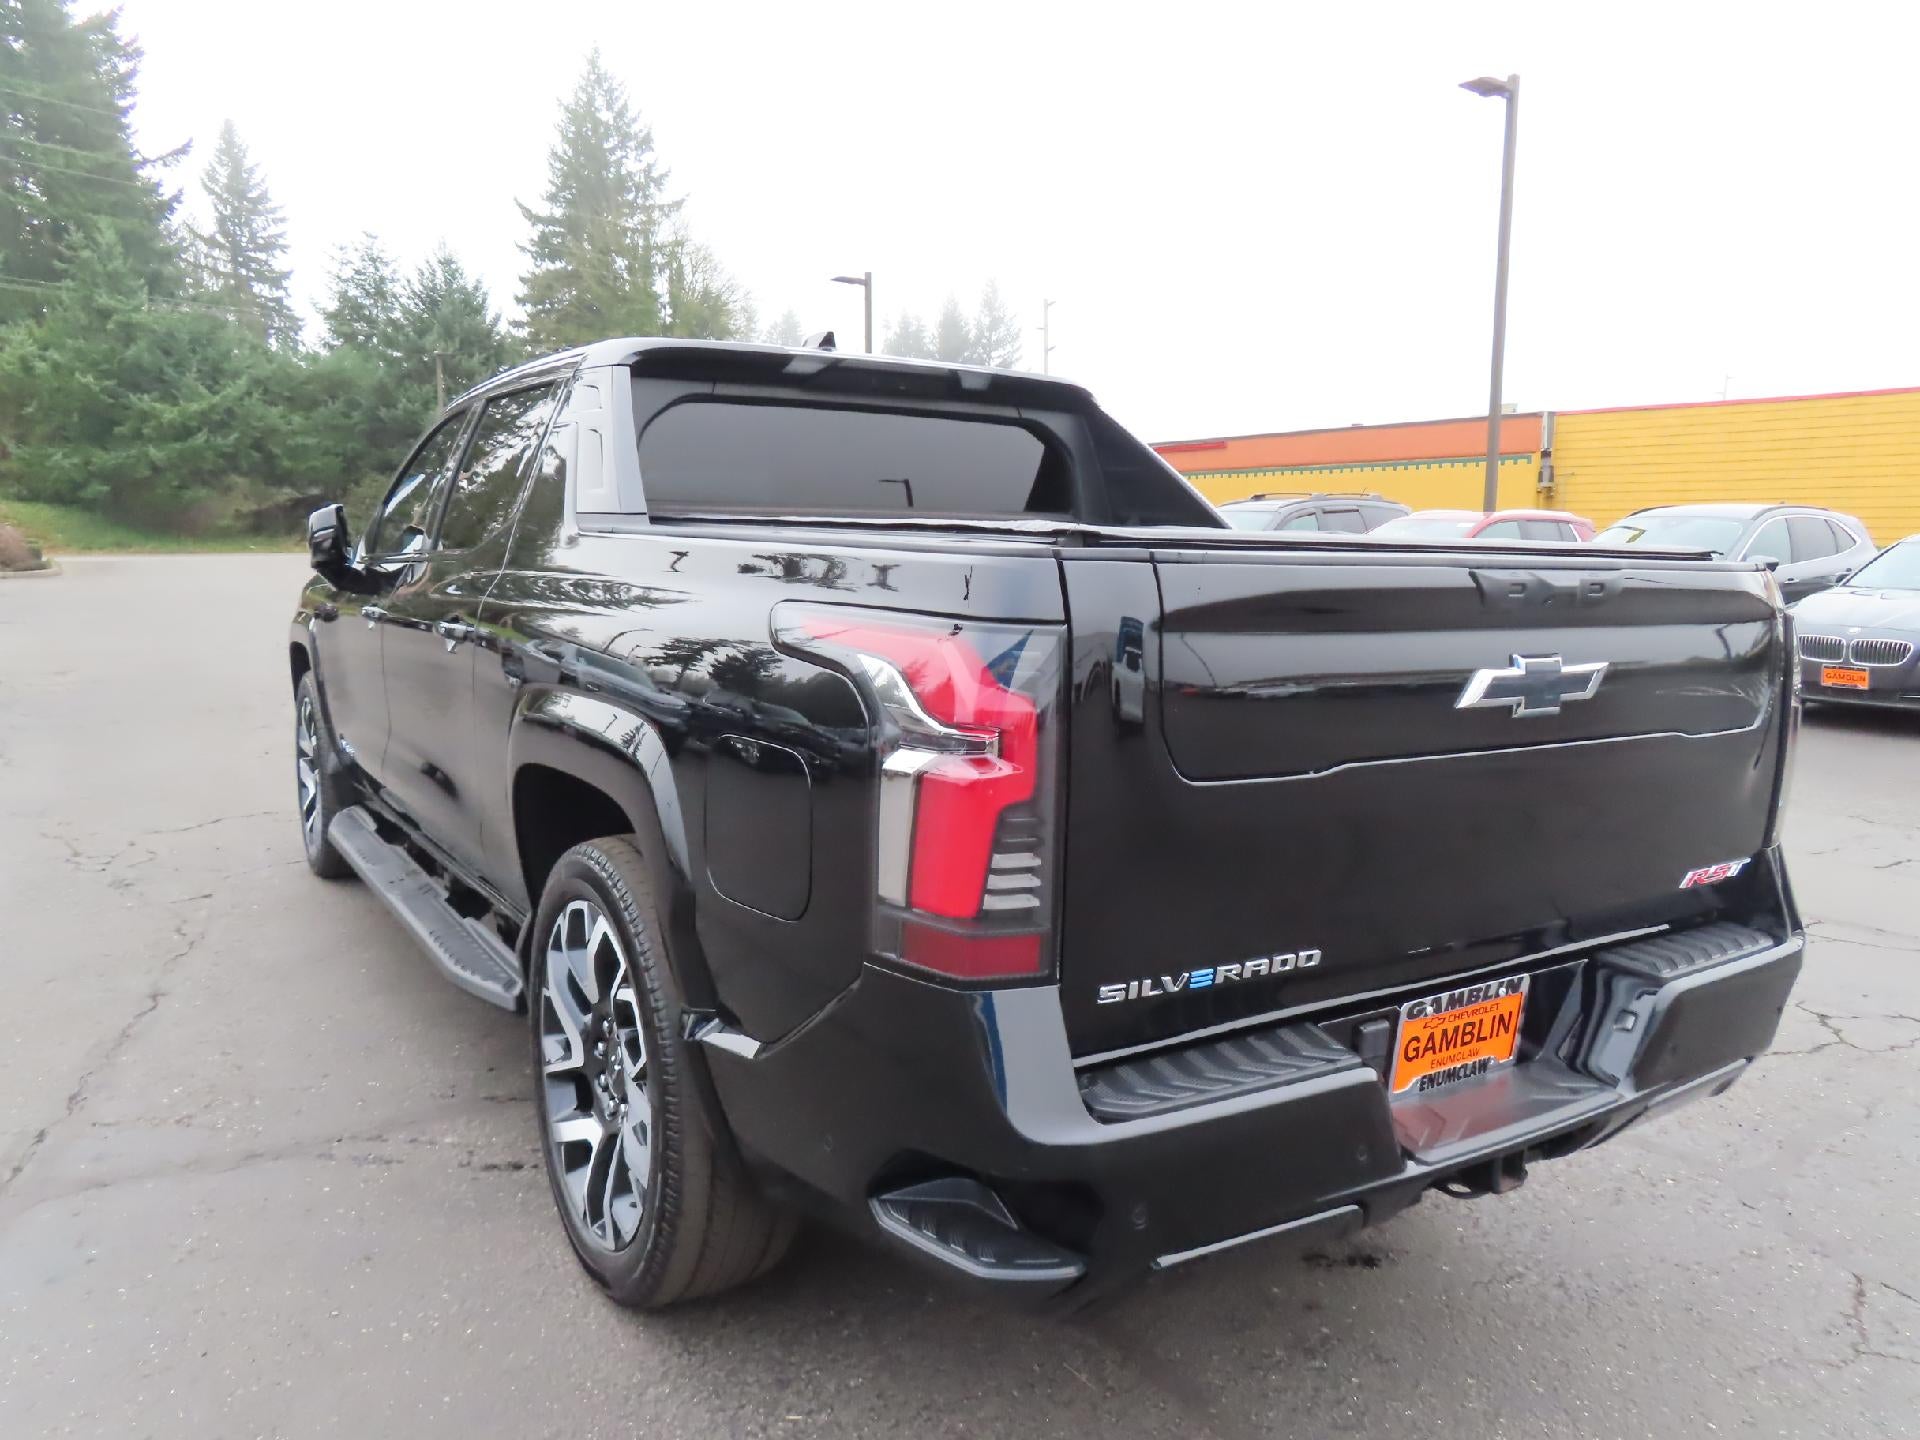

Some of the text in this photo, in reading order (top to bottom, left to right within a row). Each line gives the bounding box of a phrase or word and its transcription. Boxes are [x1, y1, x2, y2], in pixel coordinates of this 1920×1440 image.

[1679, 856, 1751, 889] RST
[1097, 949, 1322, 1004] SILVERADO
[1406, 976, 1524, 1020] GAMBLIN
[1447, 1002, 1501, 1023] CHEVROLET
[1403, 1011, 1513, 1062] GAMBLIN
[1418, 1057, 1491, 1092] ENUMCLAW
[1430, 1047, 1480, 1069] ENUMCLAW
